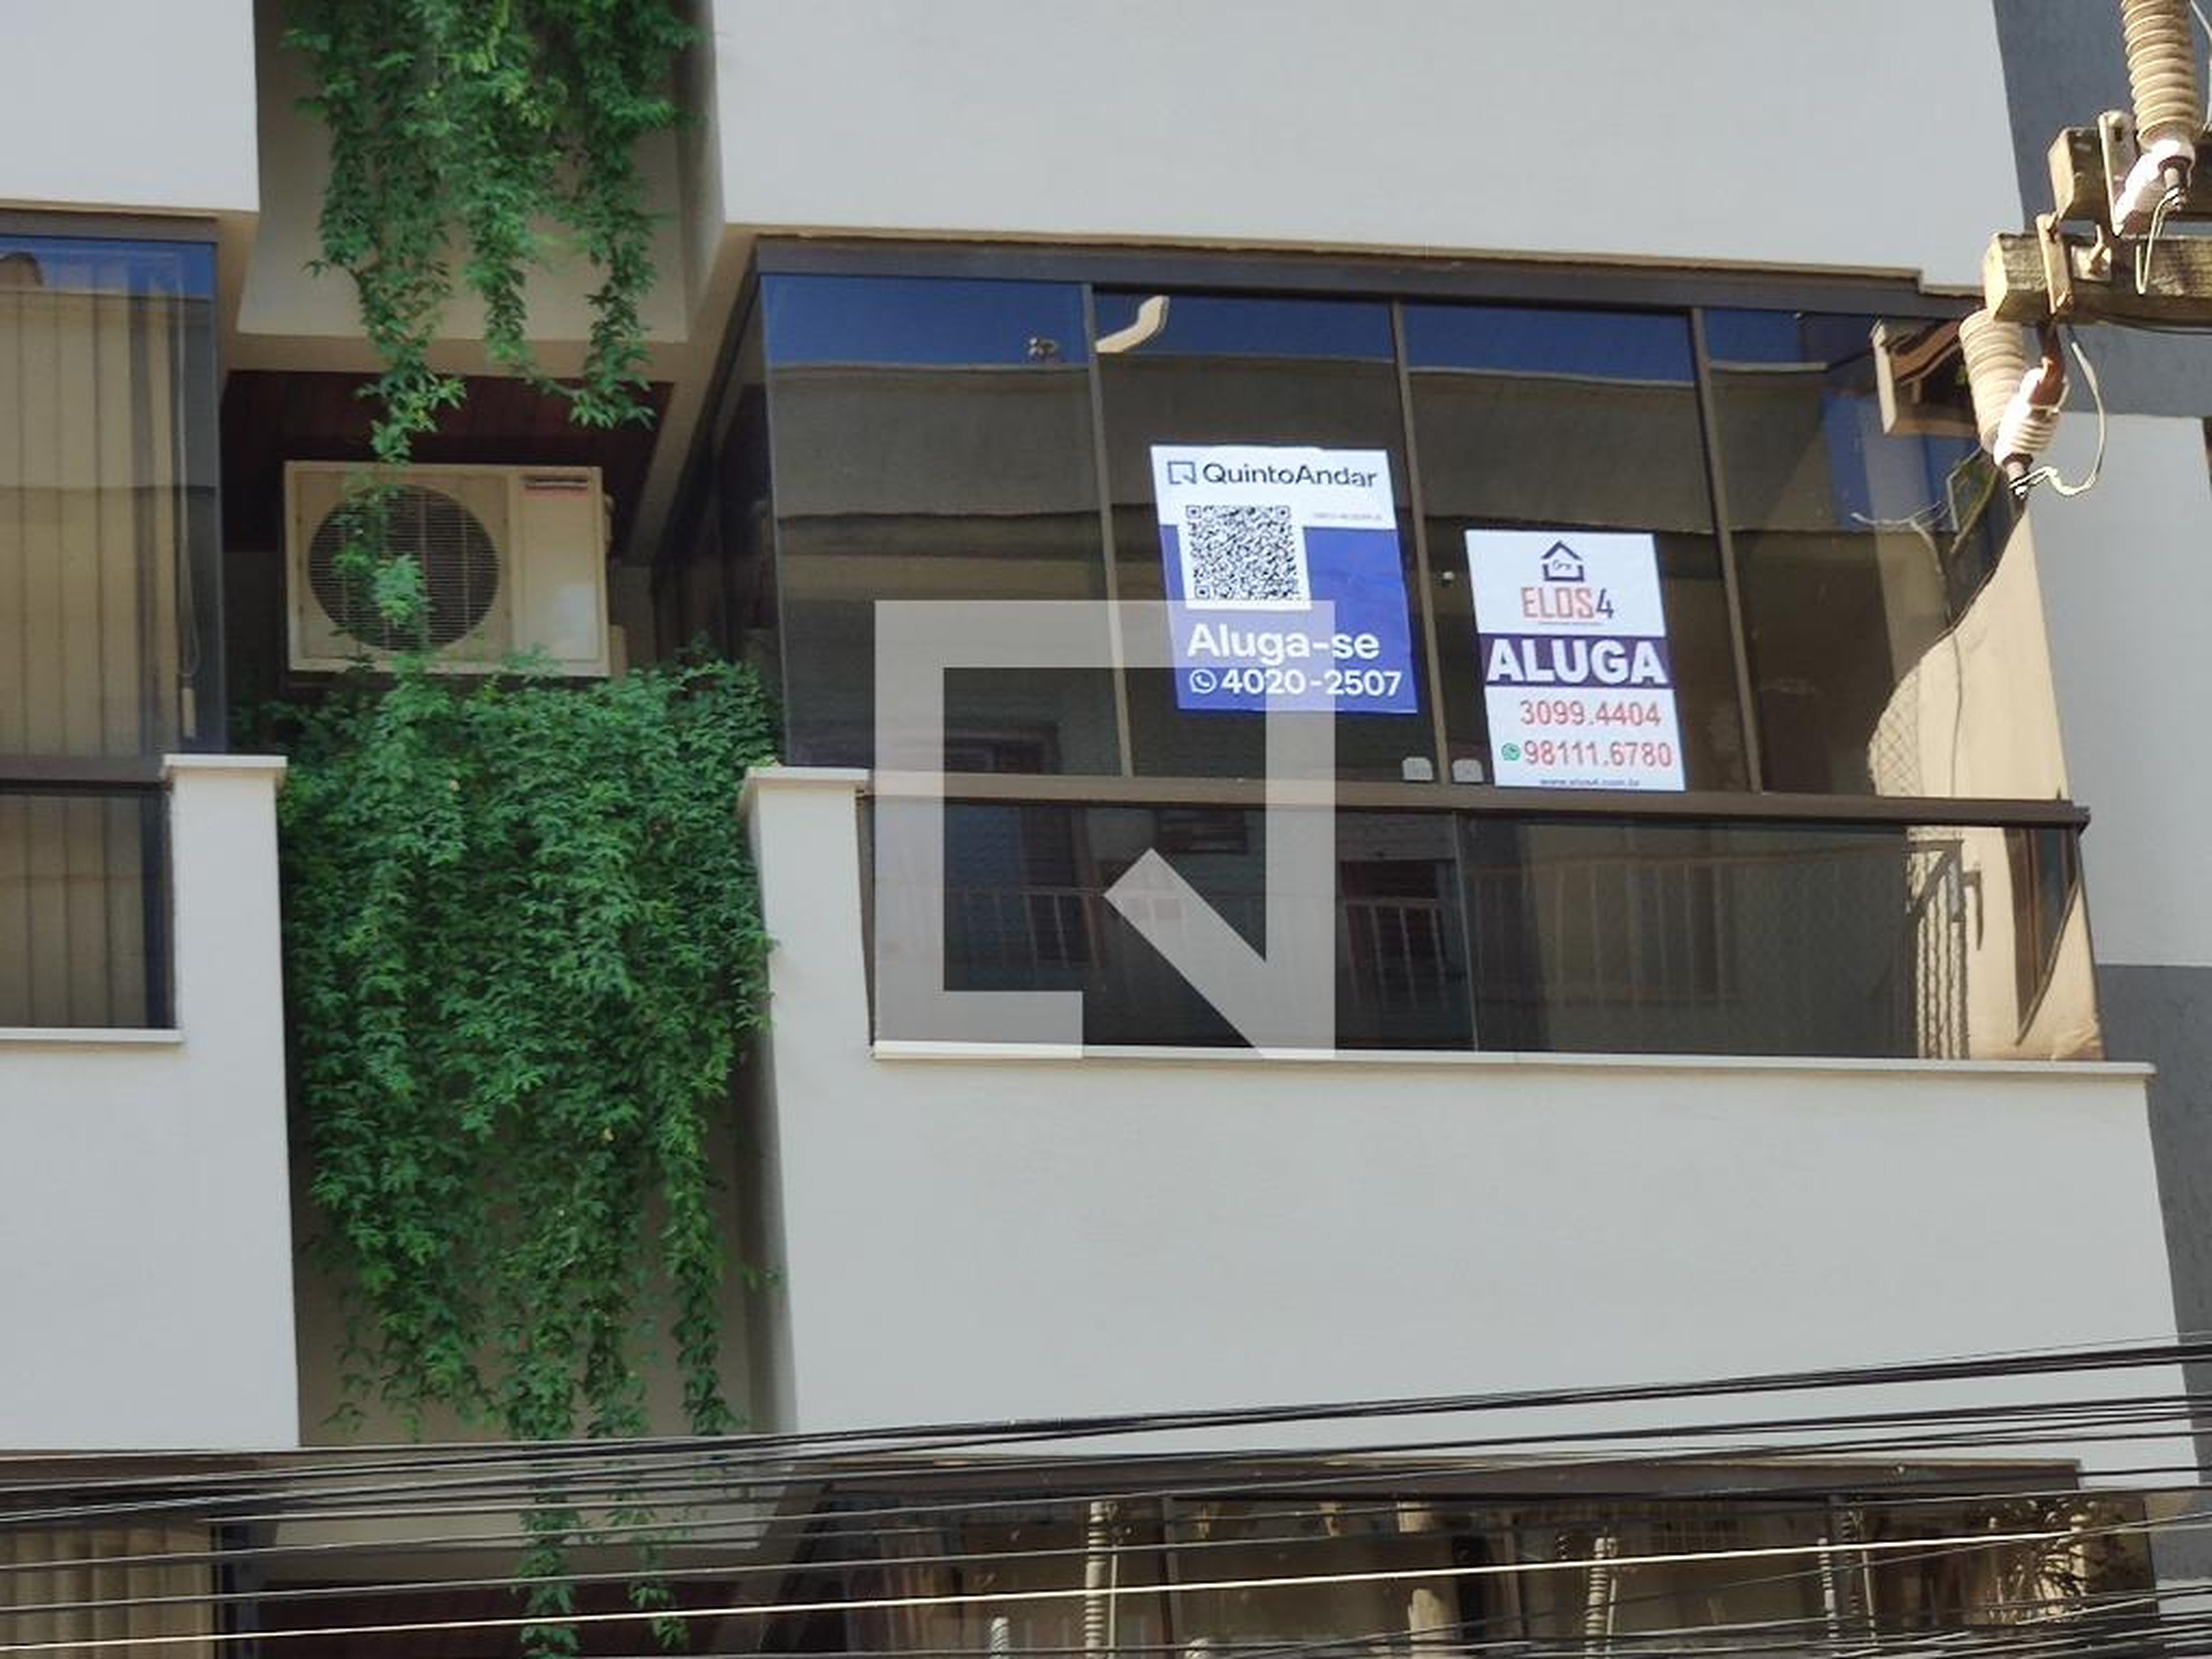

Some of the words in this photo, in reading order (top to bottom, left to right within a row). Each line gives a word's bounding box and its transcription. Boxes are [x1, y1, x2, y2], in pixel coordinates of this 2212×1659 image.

[1202, 463, 1378, 487] QuintoAndar
[1521, 586, 1614, 619] ELOS4
[1187, 623, 1380, 665] Aluga-se
[1486, 638, 1669, 684] ALUGA
[1222, 669, 1402, 696] 4020-2507
[1520, 700, 1662, 726] 3099.4404
[1524, 740, 1672, 767] 98111.6780
